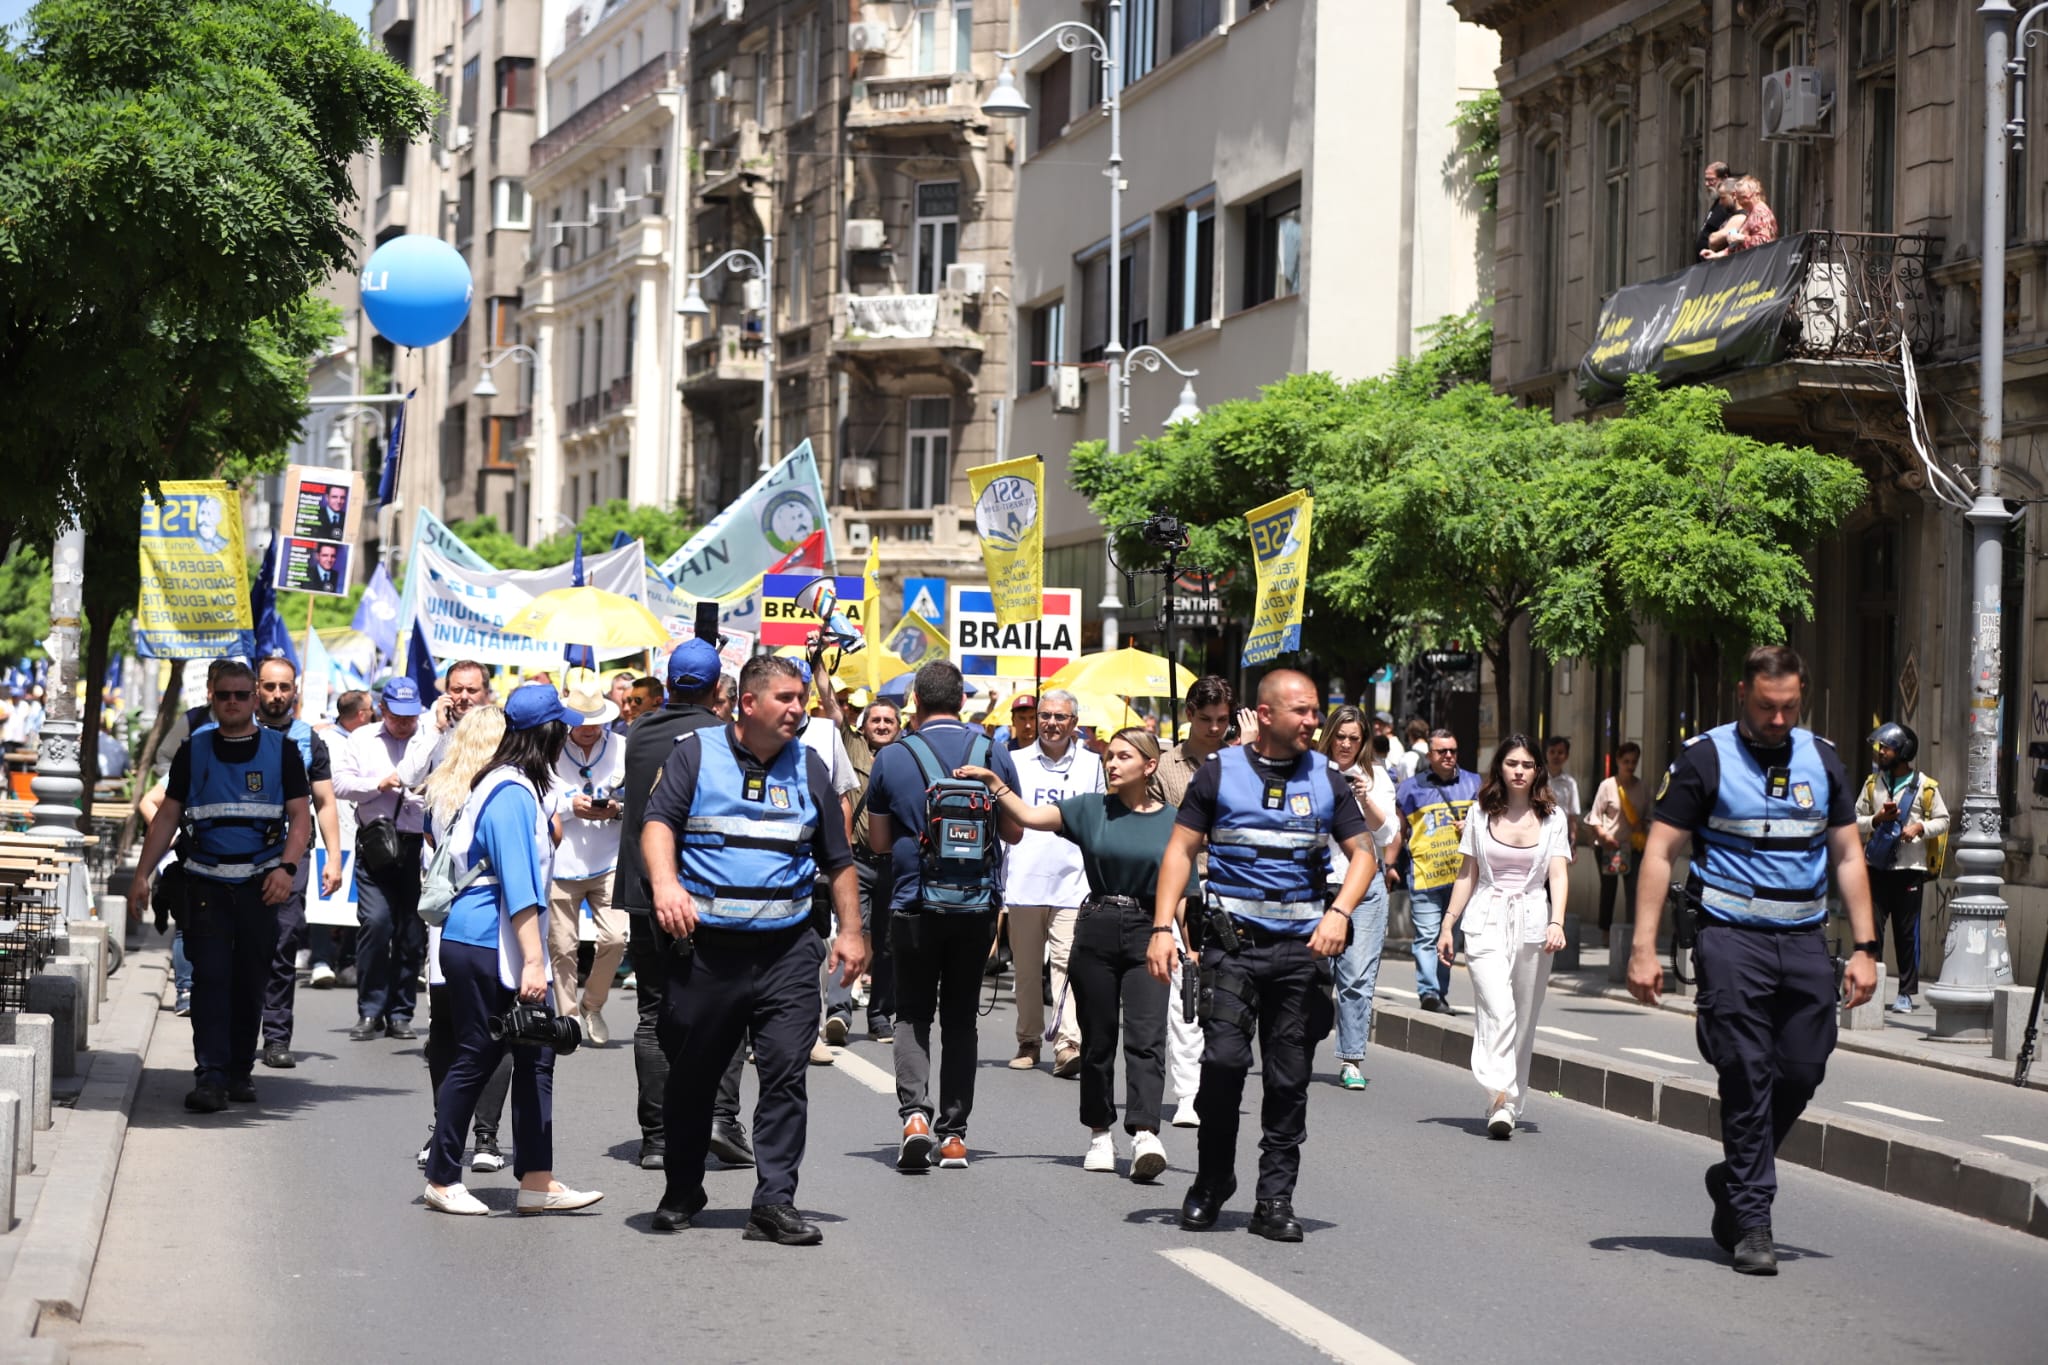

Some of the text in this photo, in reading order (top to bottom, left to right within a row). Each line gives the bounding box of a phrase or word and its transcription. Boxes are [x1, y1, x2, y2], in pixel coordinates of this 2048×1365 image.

[765, 602, 860, 620] BRAA
[960, 620, 1073, 651] BRAILA
[949, 826, 977, 840] LiveU
